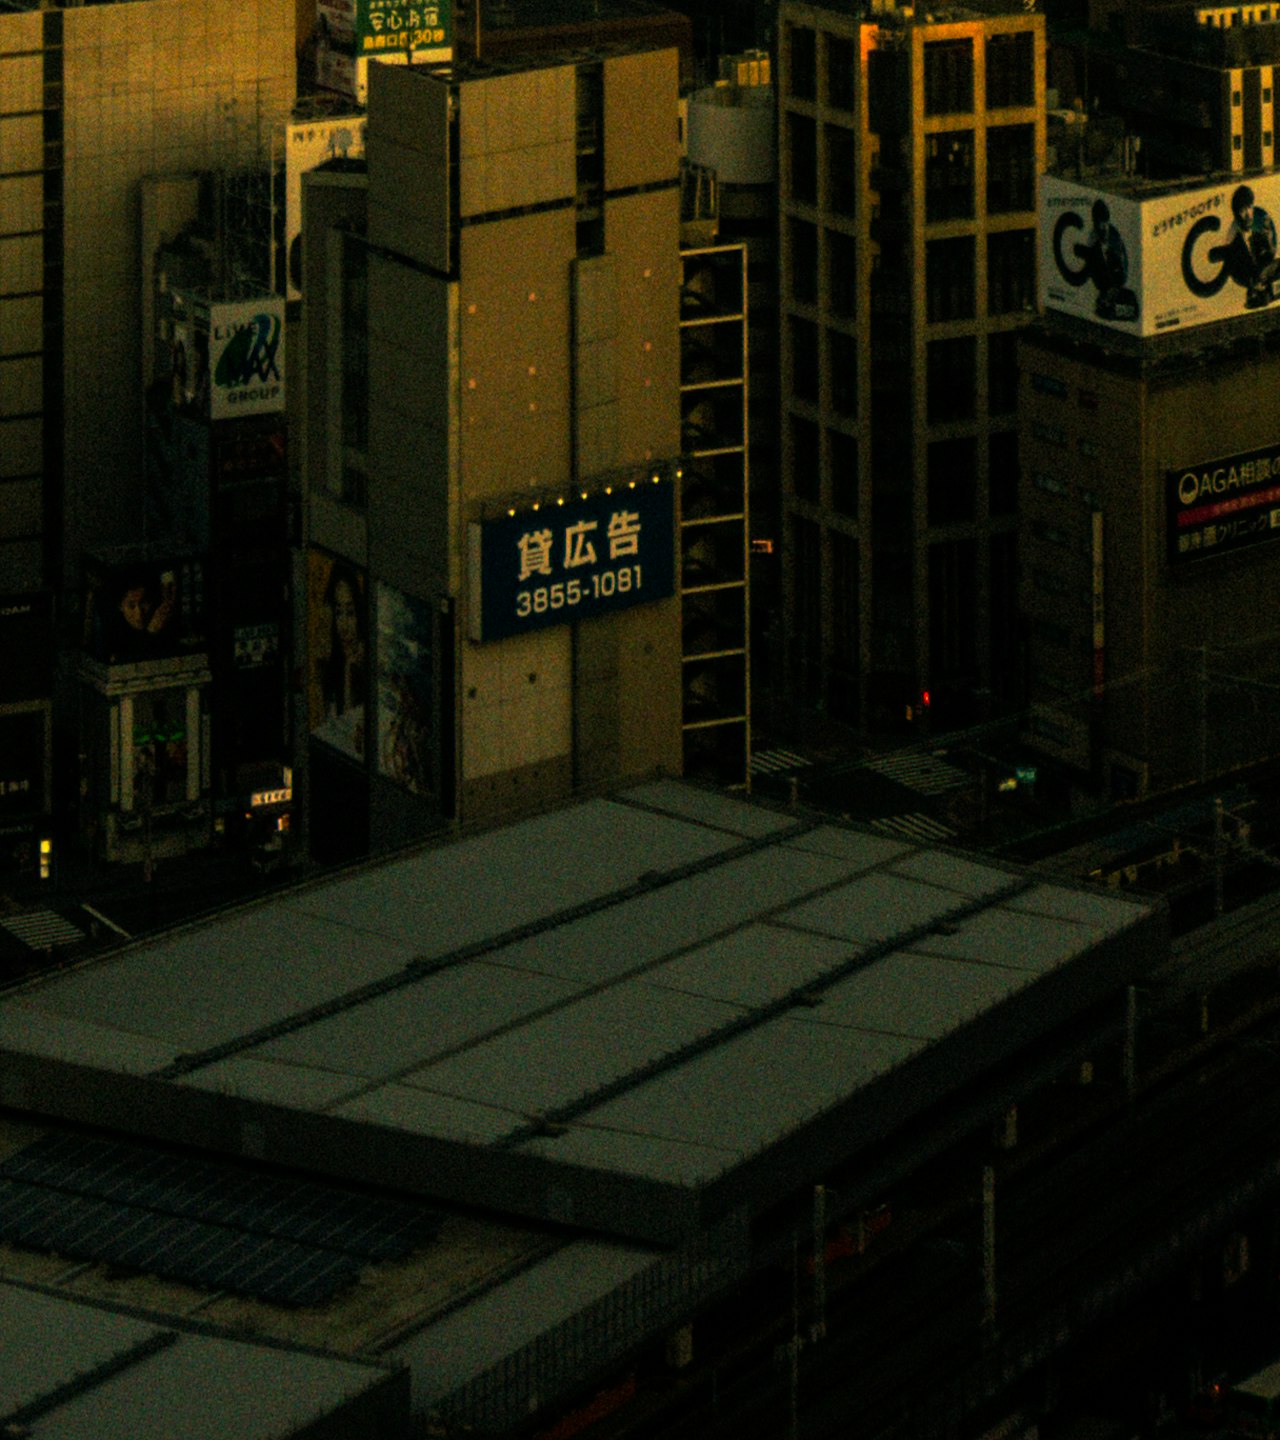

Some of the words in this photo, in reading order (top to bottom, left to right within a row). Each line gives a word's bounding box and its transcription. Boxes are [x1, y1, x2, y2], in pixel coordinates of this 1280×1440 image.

[227, 387, 280, 404] GROUP
[516, 509, 642, 583] 貸広告
[515, 564, 643, 618] 3855-1081
